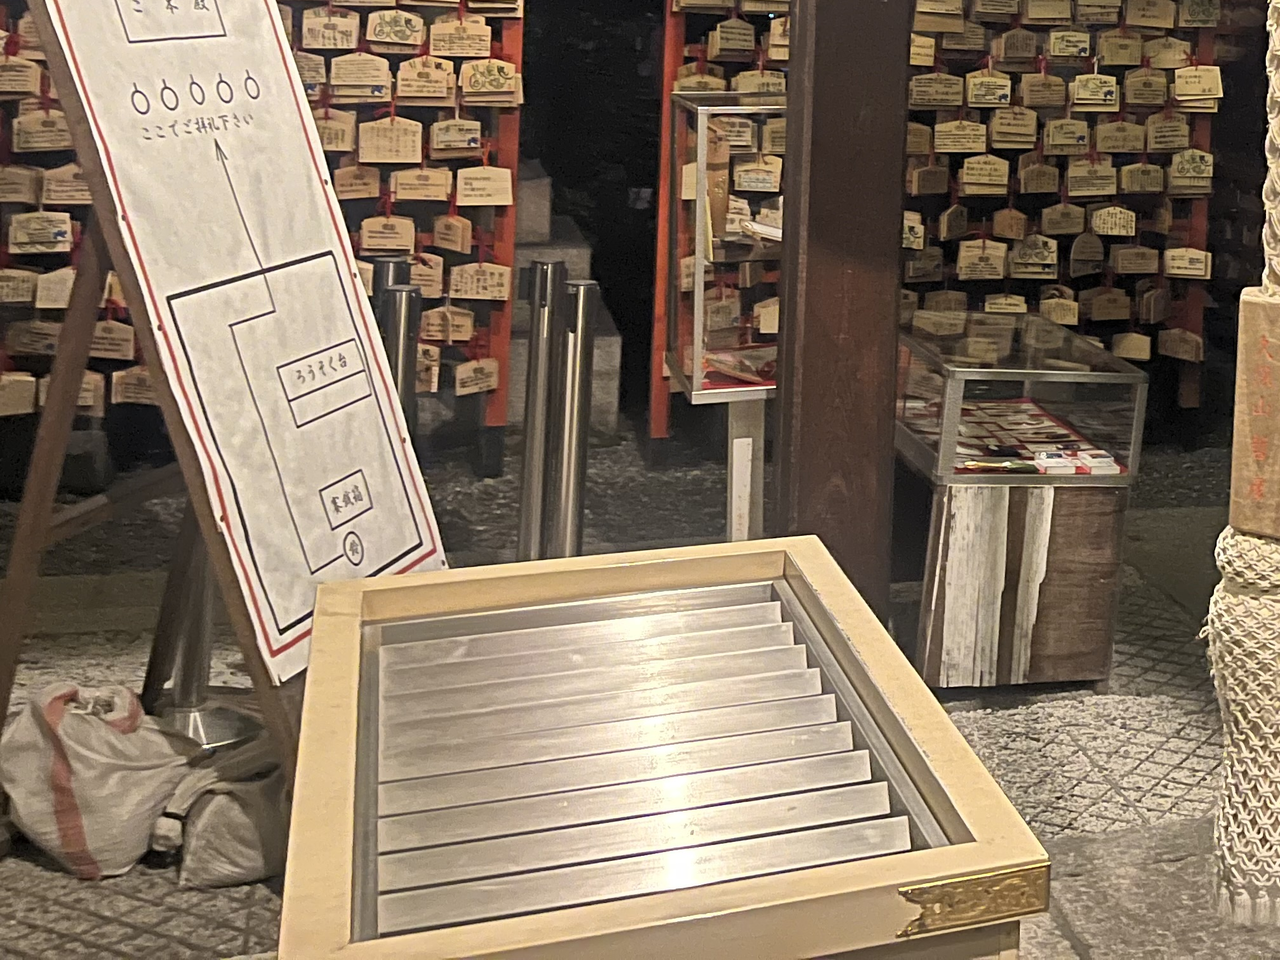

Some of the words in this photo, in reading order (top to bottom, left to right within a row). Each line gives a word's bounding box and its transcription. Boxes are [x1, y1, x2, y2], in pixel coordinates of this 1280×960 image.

[142, 113, 254, 140] ここでご拝礼下さい
[296, 353, 347, 384] ろうそく台
